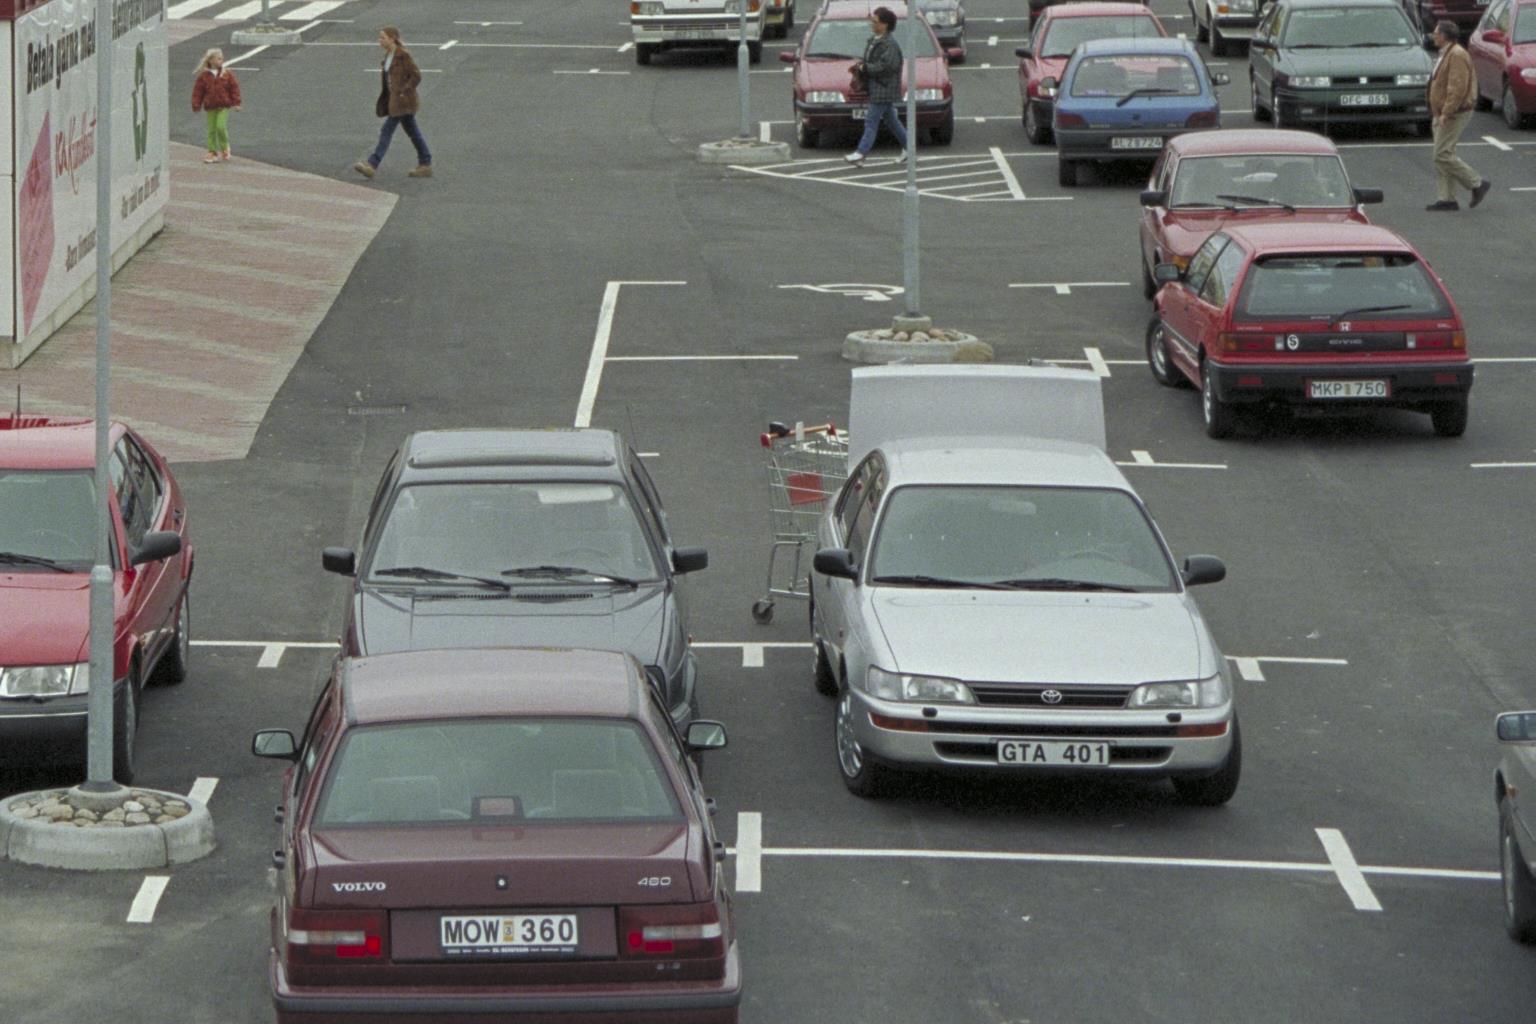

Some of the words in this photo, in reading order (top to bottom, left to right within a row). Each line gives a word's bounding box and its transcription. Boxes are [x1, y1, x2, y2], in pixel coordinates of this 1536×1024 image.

[27, 33, 54, 95] Betala
[55, 27, 78, 90] gärna
[1312, 382, 1344, 396] MKP
[1355, 382, 1386, 396] 750
[1002, 742, 1047, 762] GTA
[1062, 744, 1104, 763] 401
[332, 881, 386, 893] VOLVO
[444, 919, 501, 944] MOW
[521, 918, 575, 943] 360
